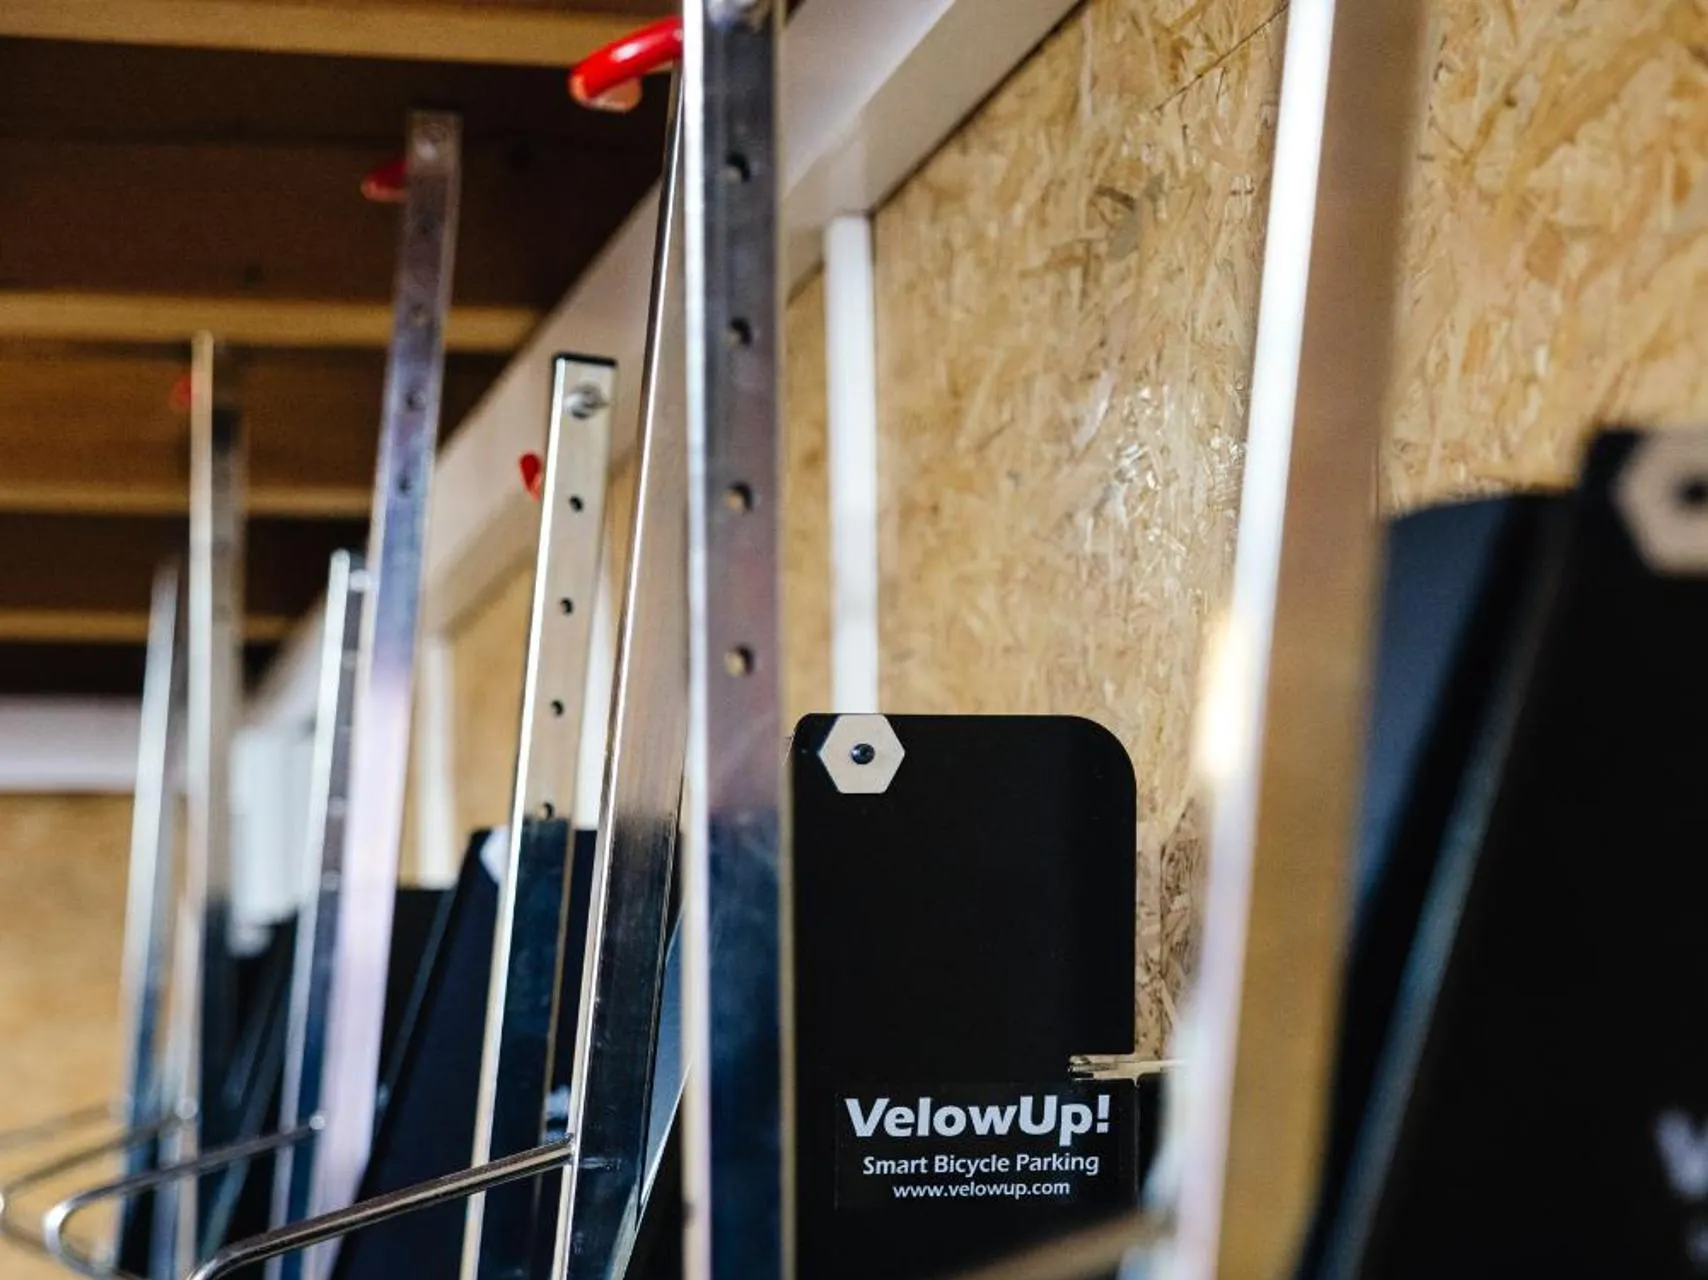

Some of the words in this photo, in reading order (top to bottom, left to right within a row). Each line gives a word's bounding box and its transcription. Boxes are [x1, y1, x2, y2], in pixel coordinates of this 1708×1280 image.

[845, 1094, 1111, 1147] VelowUp!
[862, 1155, 929, 1175] Smart
[933, 1154, 1010, 1178] Bicycle
[1015, 1153, 1100, 1176] Parking
[892, 1181, 1071, 1199] www.velowup.com
